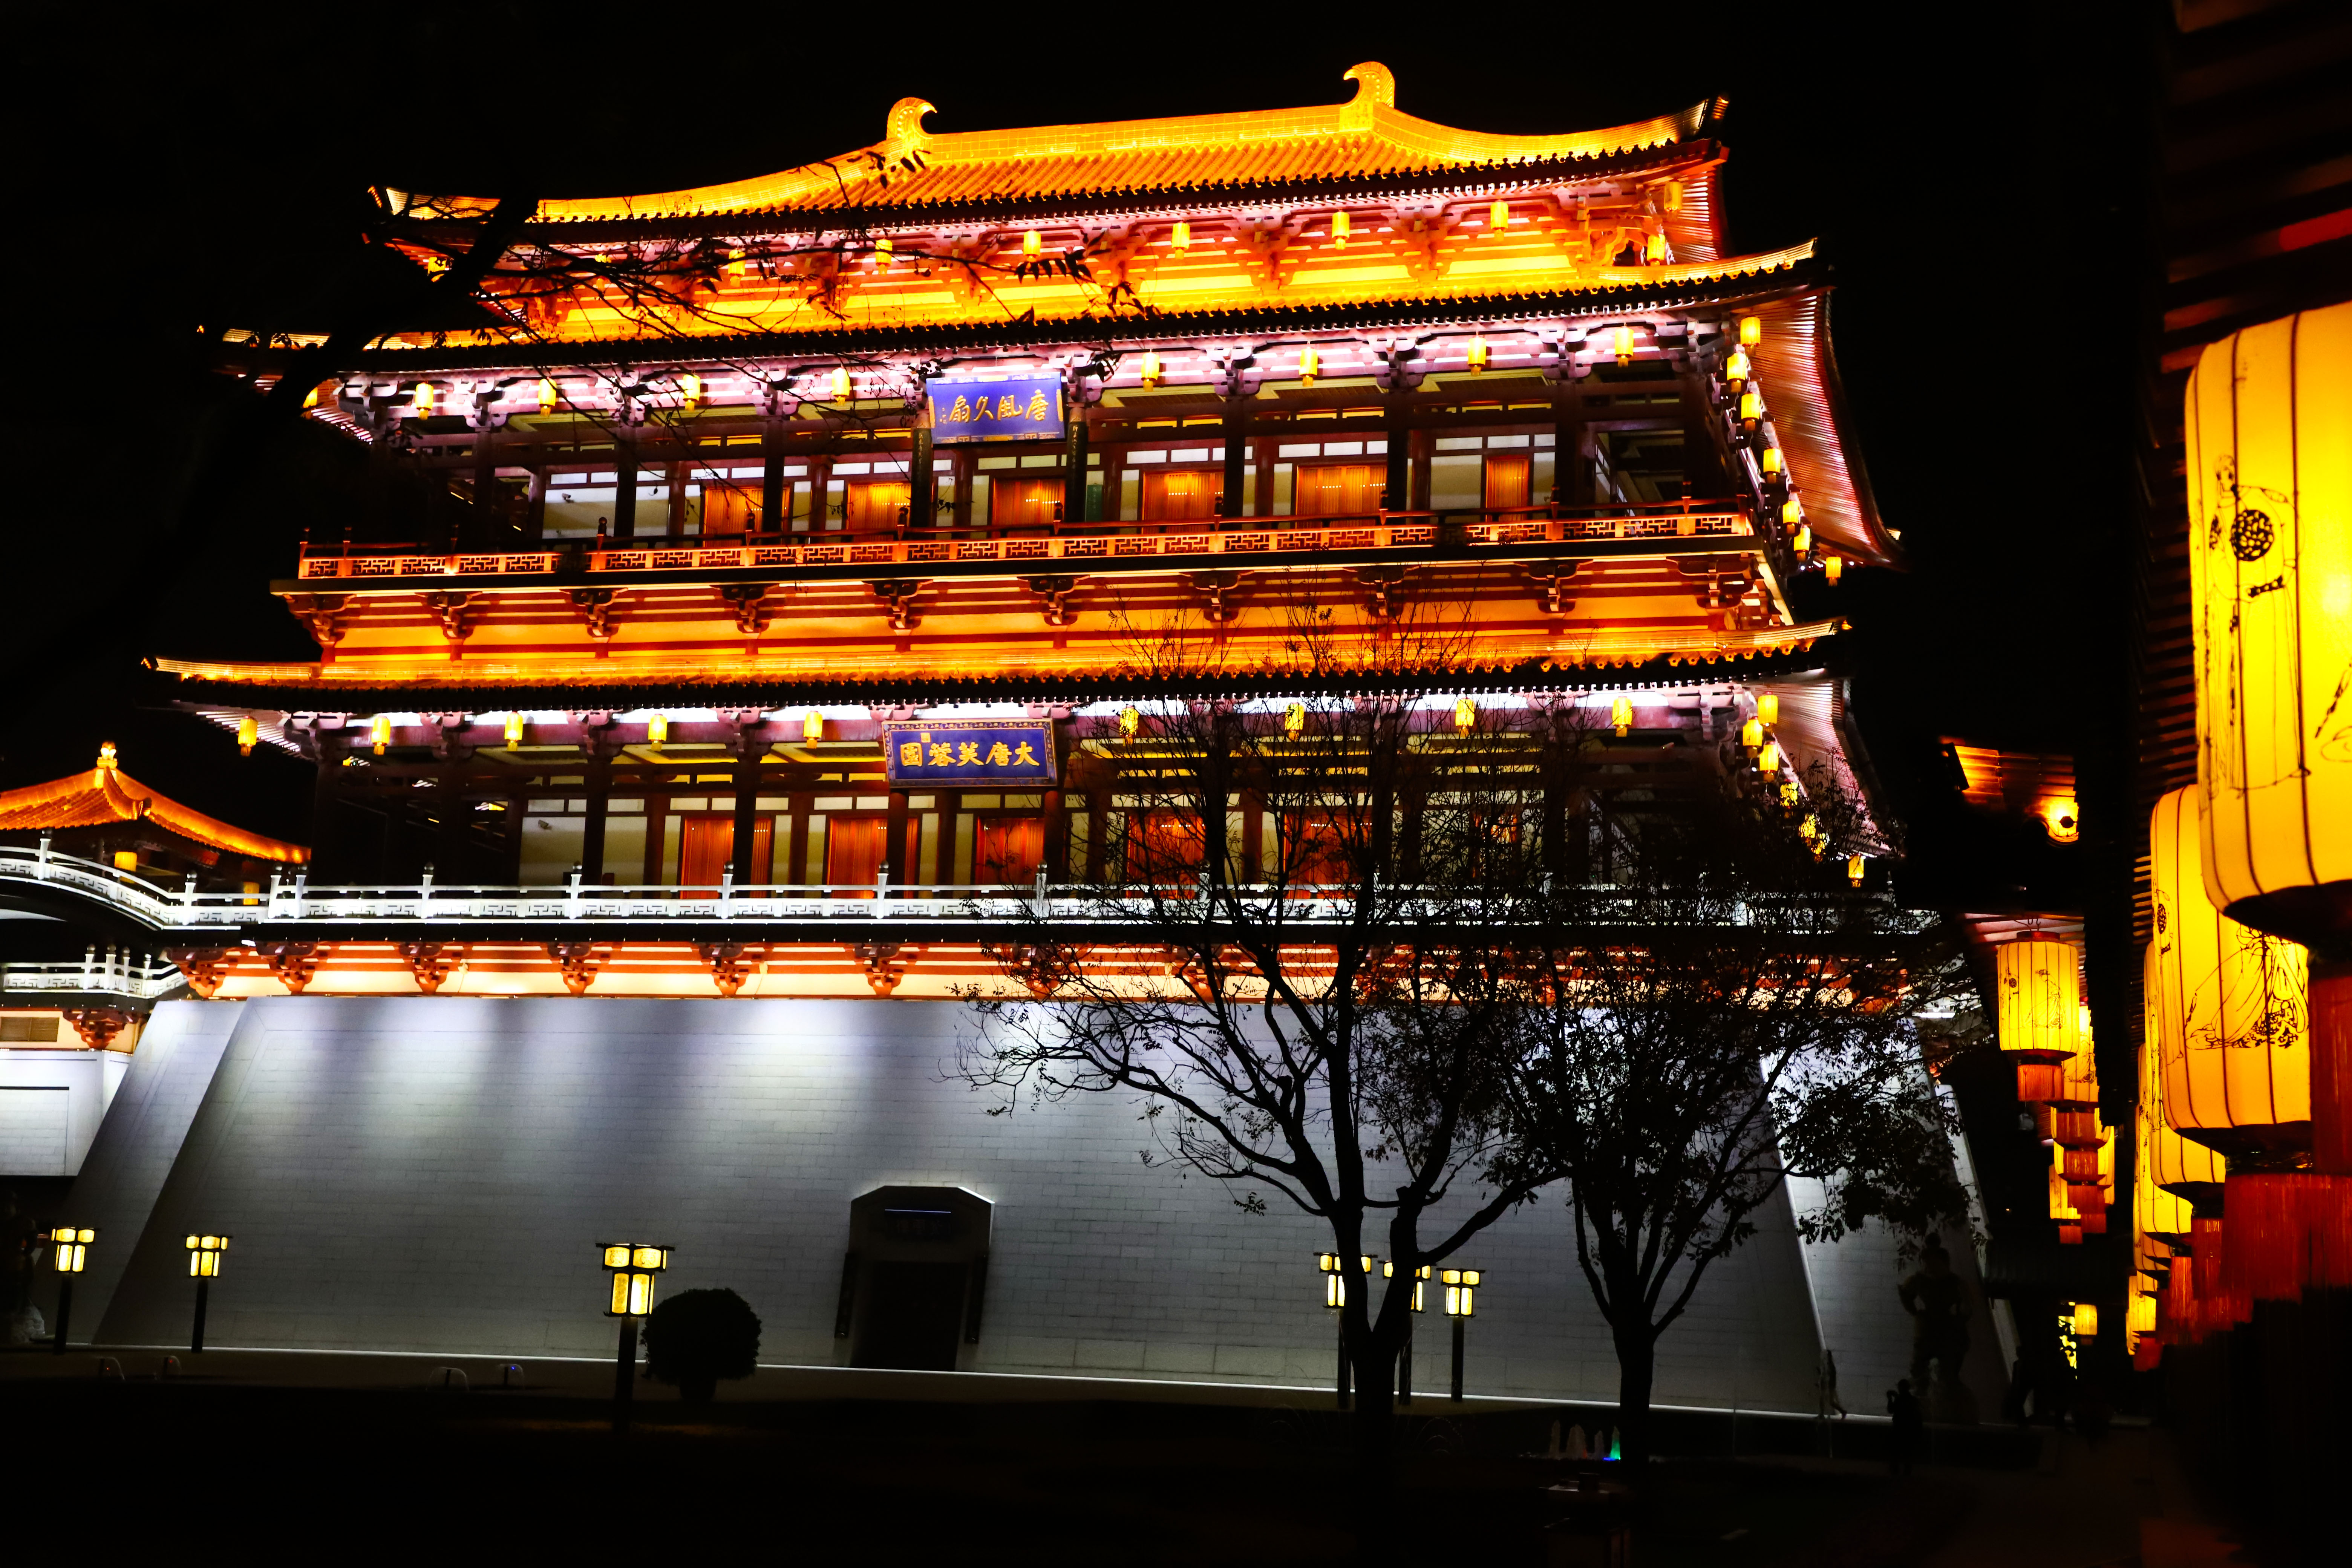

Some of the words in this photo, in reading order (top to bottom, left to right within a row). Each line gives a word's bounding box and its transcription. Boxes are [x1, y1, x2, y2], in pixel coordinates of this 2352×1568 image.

[900, 741, 1040, 767] 大唐芙蓉園
